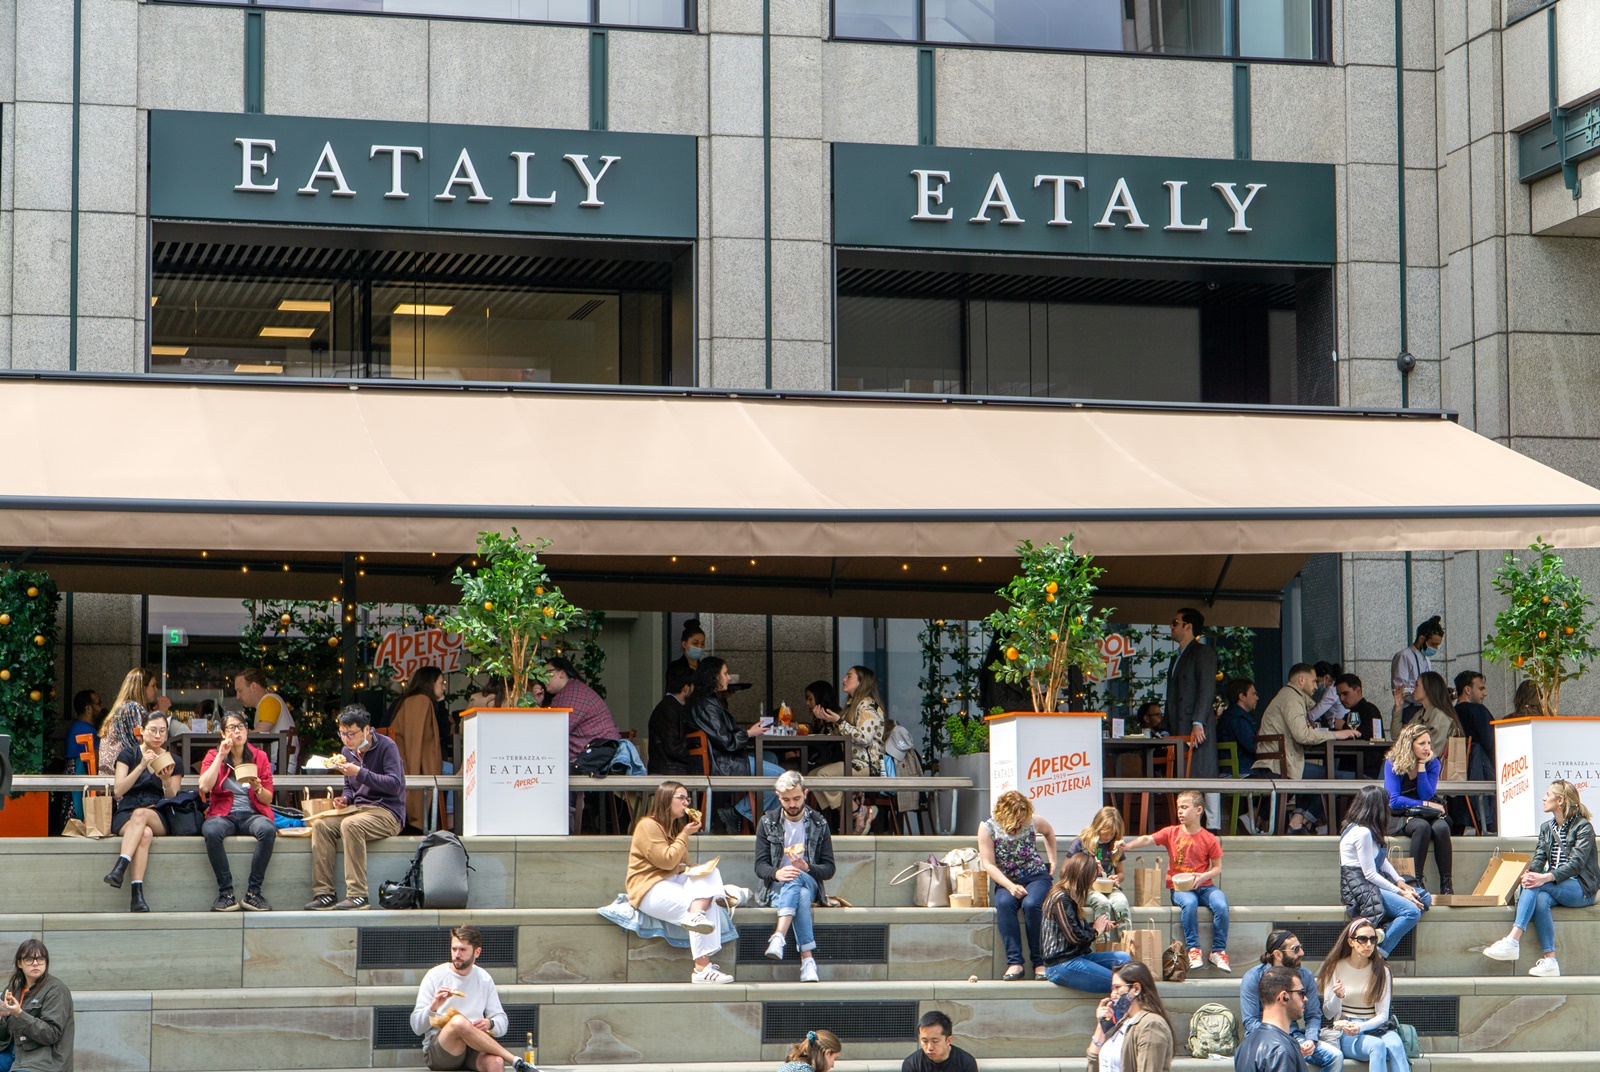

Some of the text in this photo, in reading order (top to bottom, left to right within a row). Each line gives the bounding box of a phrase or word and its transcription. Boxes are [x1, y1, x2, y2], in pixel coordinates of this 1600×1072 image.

[233, 137, 622, 208] EATALY
[909, 169, 1268, 234] EATALY
[489, 764, 556, 775] EATALY
[1027, 751, 1091, 780] APEROL
[1501, 755, 1529, 785] APEROL
[513, 777, 539, 788] APEROL
